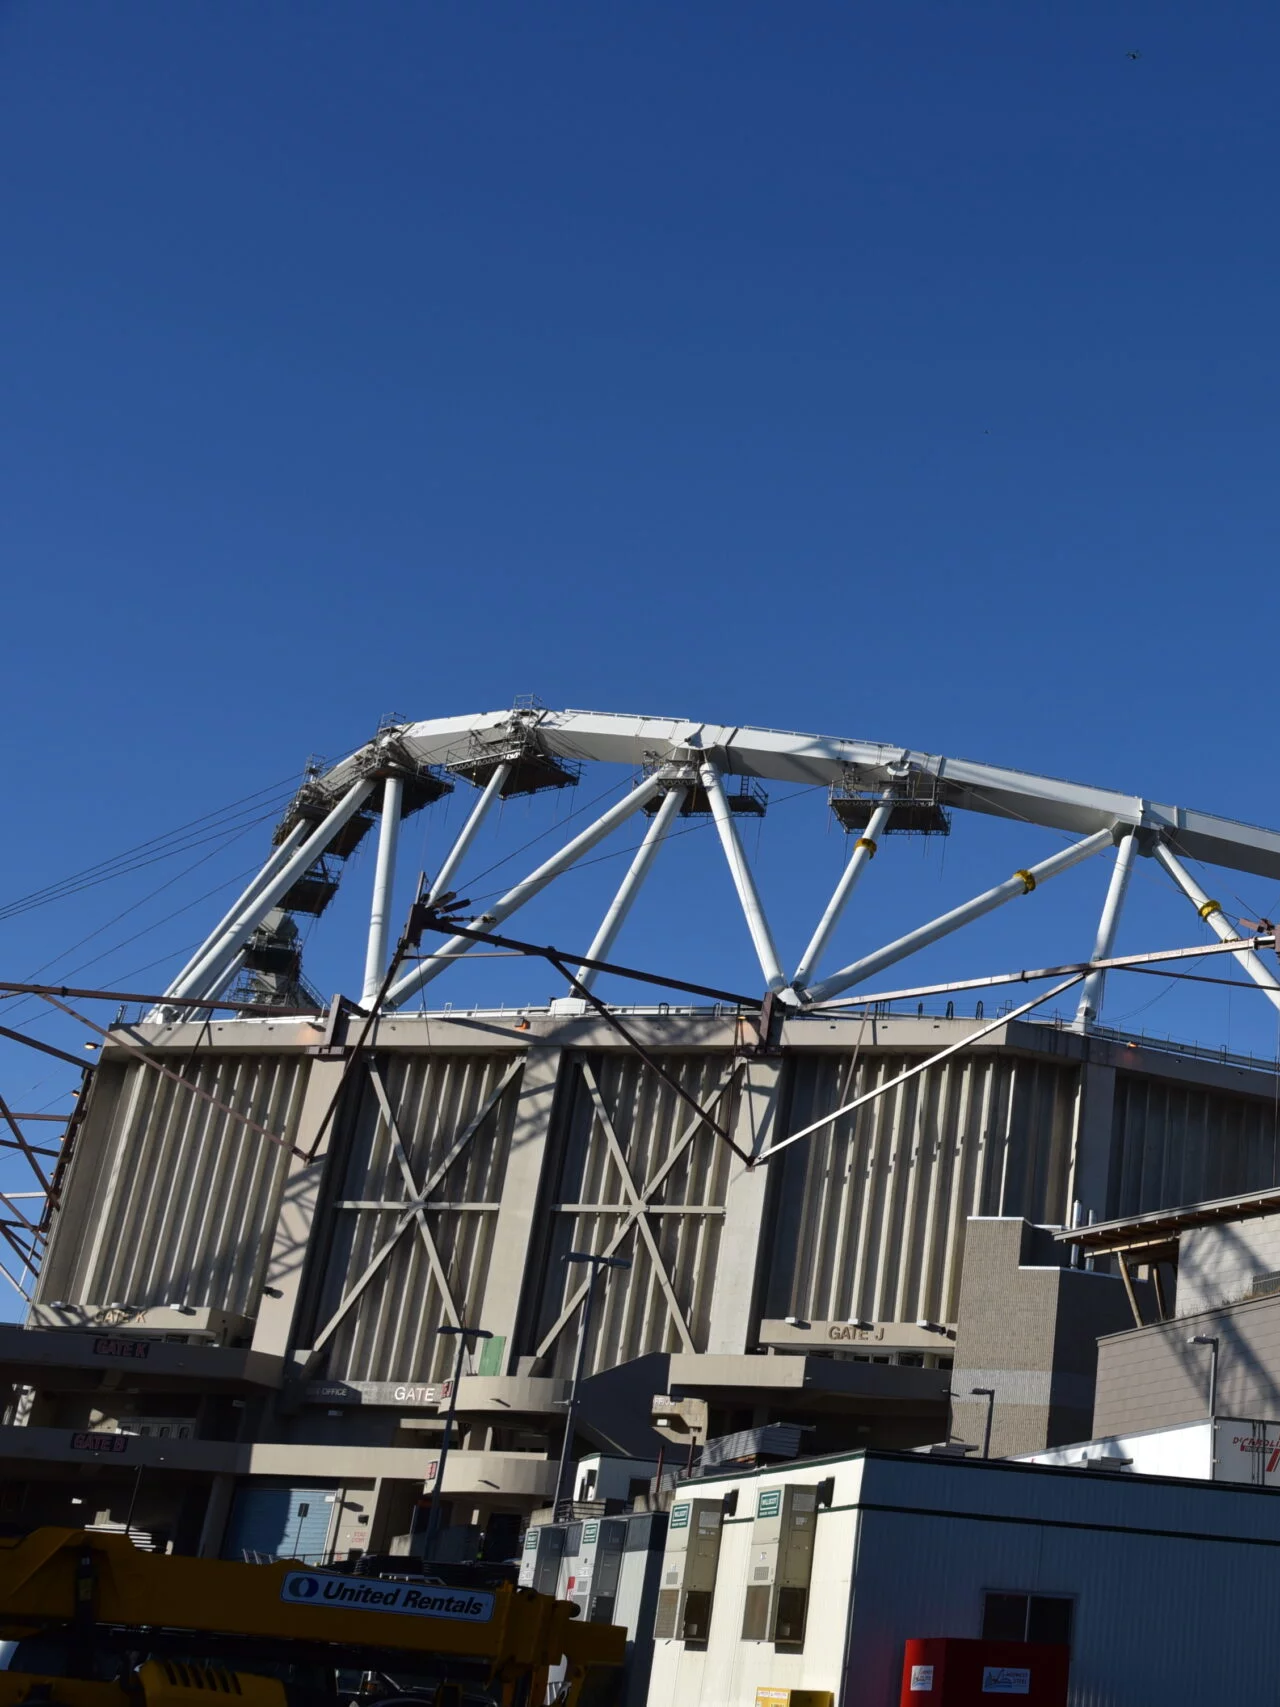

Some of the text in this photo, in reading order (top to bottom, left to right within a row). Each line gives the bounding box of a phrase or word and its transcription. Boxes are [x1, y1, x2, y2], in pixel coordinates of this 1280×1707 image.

[94, 1308, 147, 1323] GATE K
[828, 1325, 885, 1341] GATE J
[96, 1340, 146, 1357] GATE K
[321, 1387, 348, 1397] OFFICE
[394, 1386, 436, 1402] GATE
[73, 1434, 112, 1451] GATE
[322, 1580, 484, 1615] United Rentals
